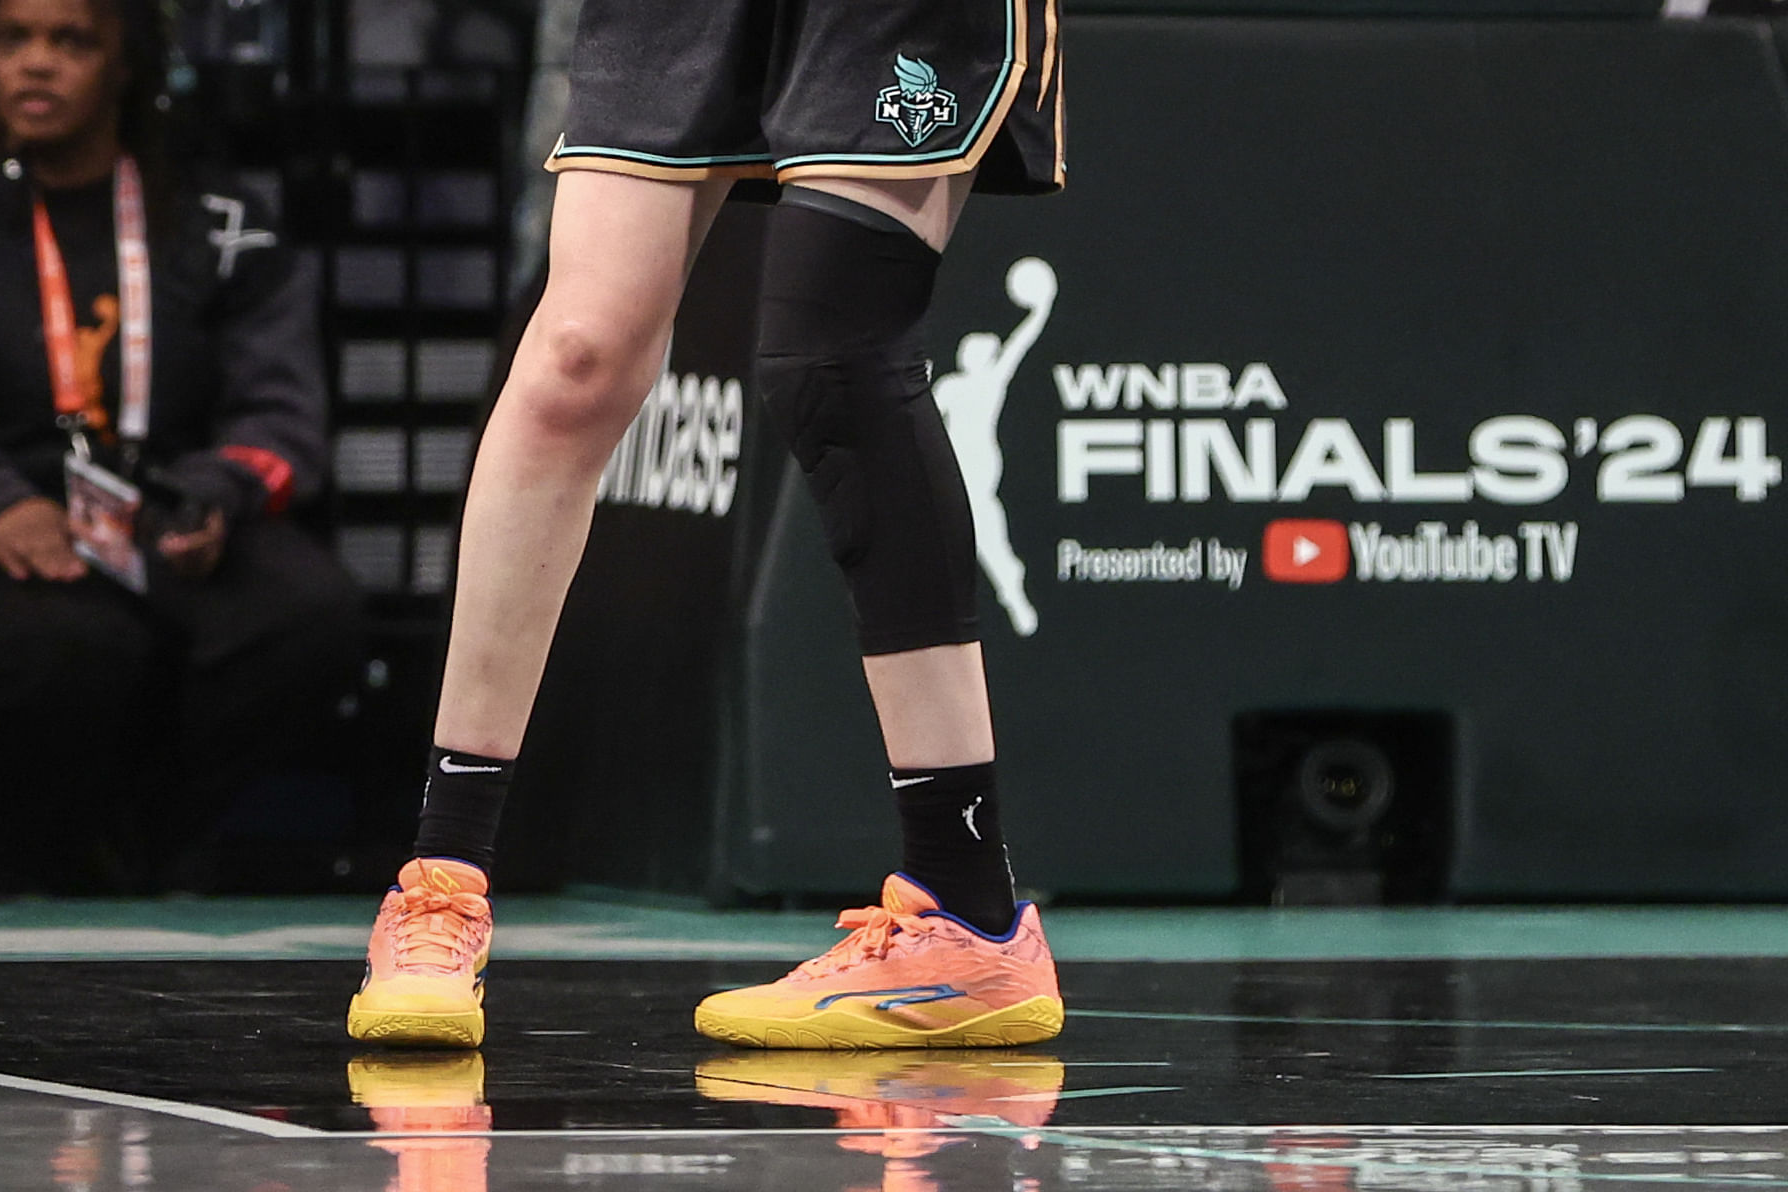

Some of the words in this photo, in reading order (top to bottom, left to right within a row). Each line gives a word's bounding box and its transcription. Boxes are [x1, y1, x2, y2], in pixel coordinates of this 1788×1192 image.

[1052, 362, 1289, 411] WNBA
[1056, 537, 1204, 582] Presented
[1207, 537, 1248, 591] by
